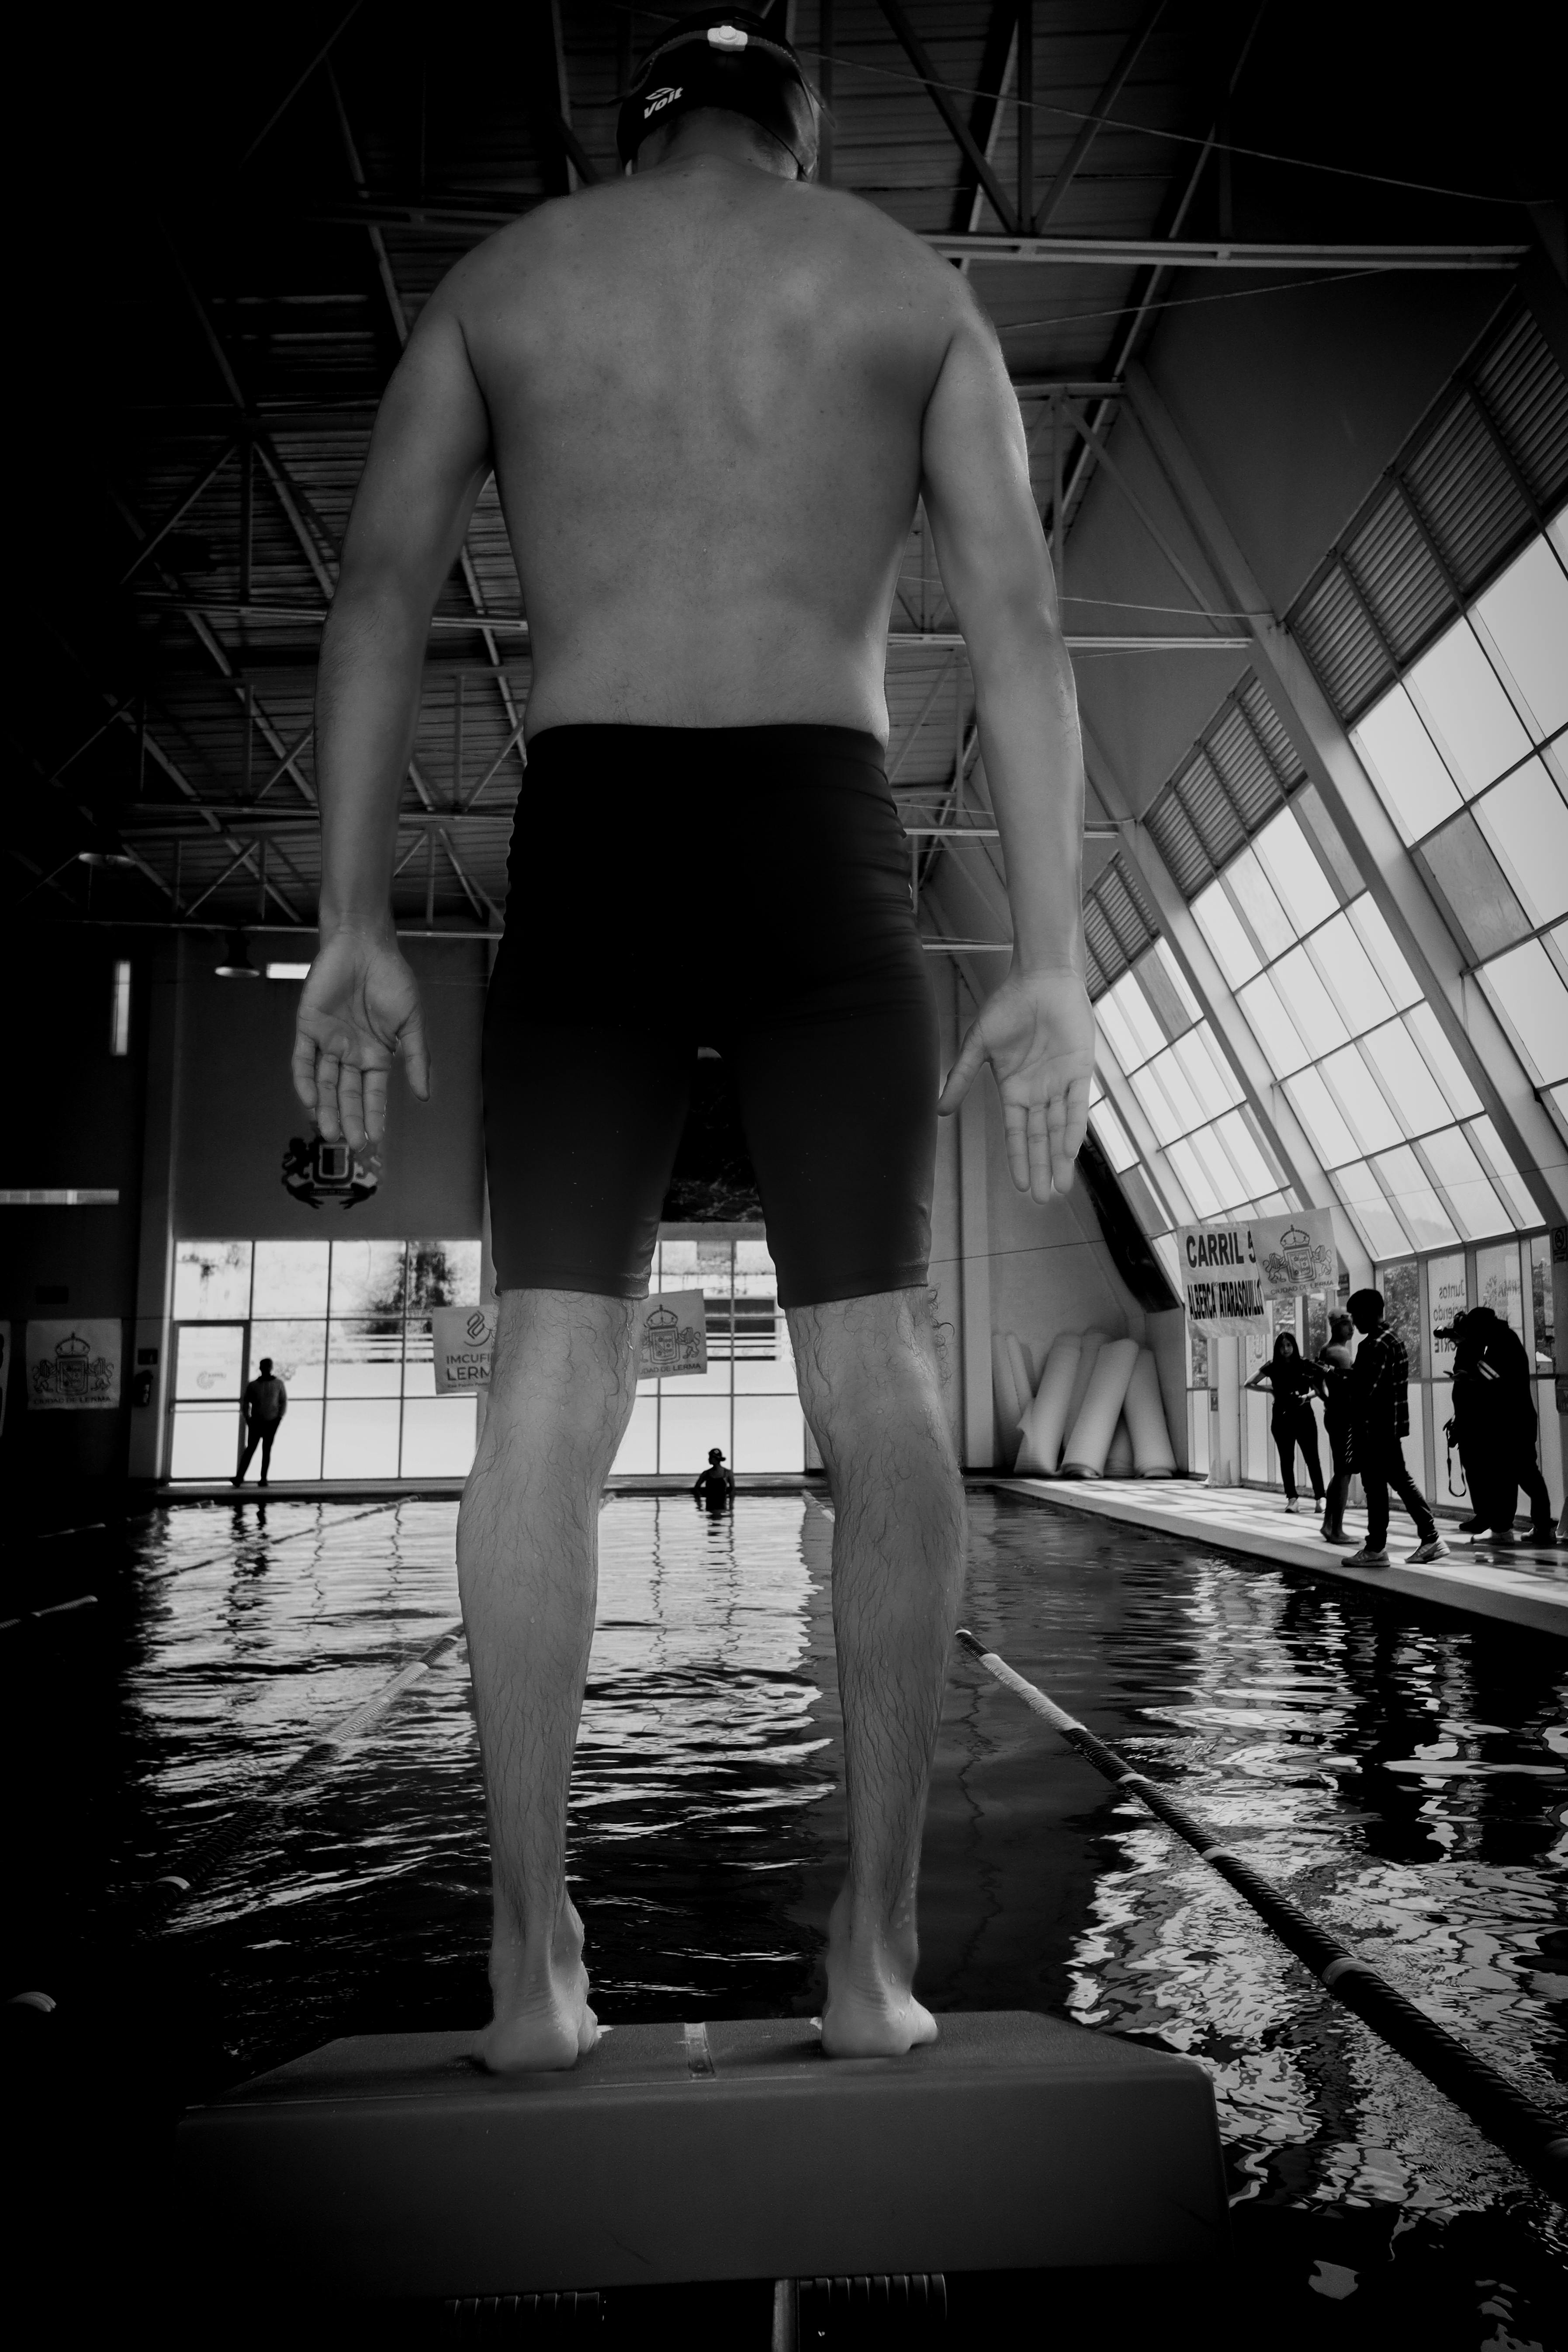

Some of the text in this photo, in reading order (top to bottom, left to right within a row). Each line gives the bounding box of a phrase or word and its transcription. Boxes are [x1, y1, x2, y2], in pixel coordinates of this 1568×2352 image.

[1186, 1232, 1244, 1268] CARRIL
[1270, 1286, 1298, 1295] CIUDAD
[1310, 1280, 1333, 1289] LERMA
[1187, 1282, 1217, 1320] ALBERCA
[447, 1354, 490, 1364] IMCUFI
[447, 1366, 490, 1381] LERM
